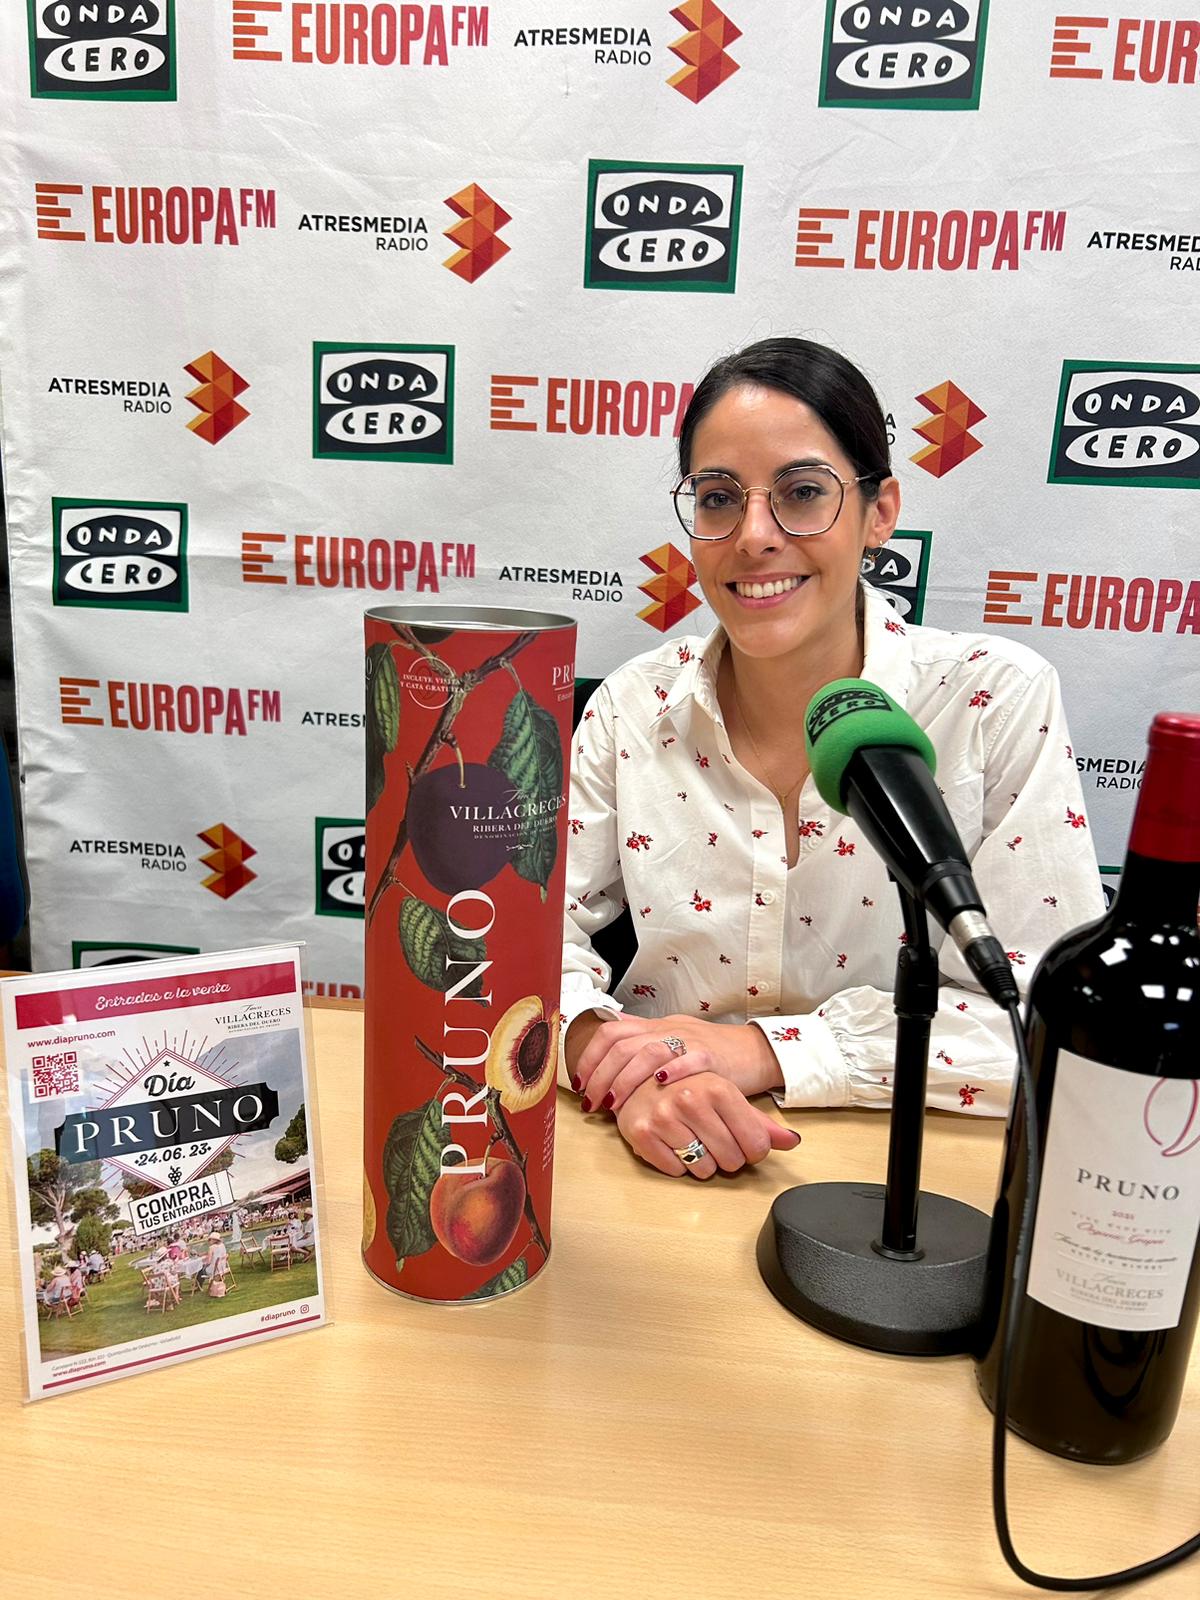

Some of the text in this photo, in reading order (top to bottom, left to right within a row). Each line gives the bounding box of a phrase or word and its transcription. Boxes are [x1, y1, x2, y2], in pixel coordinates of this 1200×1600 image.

[54, 1, 149, 26] ONDA
[852, 5, 957, 29] ONDA
[291, 3, 488, 66] EUROPA FM
[514, 27, 651, 47] ATRESMEDIA
[62, 46, 149, 72] CERO
[594, 49, 651, 66] RADIO
[855, 52, 954, 79] CERO
[92, 185, 276, 245] EUROPA FM
[612, 194, 711, 217] ONDA
[298, 214, 428, 235] ATRESMEDIA
[376, 237, 428, 252] RADIO
[616, 238, 710, 263] CERO
[854, 210, 1067, 271] EUROPA FM
[48, 377, 171, 398] ATRESMEDIA
[336, 371, 428, 393] ONDA
[124, 400, 172, 414] RADIO
[1085, 393, 1186, 414] ONDA
[342, 411, 426, 435] CERO
[1084, 434, 1182, 458] CERO
[77, 526, 162, 547] ONDA
[80, 563, 162, 586] CERO
[294, 535, 475, 594] EUROPA FM
[499, 566, 623, 588] ATRESMEDIA
[572, 588, 623, 603] RADIO
[403, 674, 432, 683] INCLUYE
[406, 682, 423, 690] CATA
[426, 684, 464, 693] GRATUITA
[107, 681, 281, 736] EUROPA FM
[450, 793, 566, 820] VILLACRECES
[473, 824, 511, 833] RIBERA
[70, 840, 186, 858] ATRESMEDIA
[141, 858, 187, 872] RADIO
[95, 982, 231, 1011] Entradas a la venta
[215, 1007, 291, 1025] VILLACRECES
[27, 1030, 116, 1048] www.diapruno.com
[441, 889, 495, 1178] PRUNO
[144, 1072, 196, 1096] Día
[73, 1094, 263, 1154] PRUNO
[1076, 1168, 1179, 1201] PRUNO
[137, 1182, 213, 1220] COMPRA
[139, 1197, 216, 1230] TUS ENTRADAS
[1056, 1268, 1164, 1299] VILLACRECES
[261, 1309, 296, 1322] #diapruno
